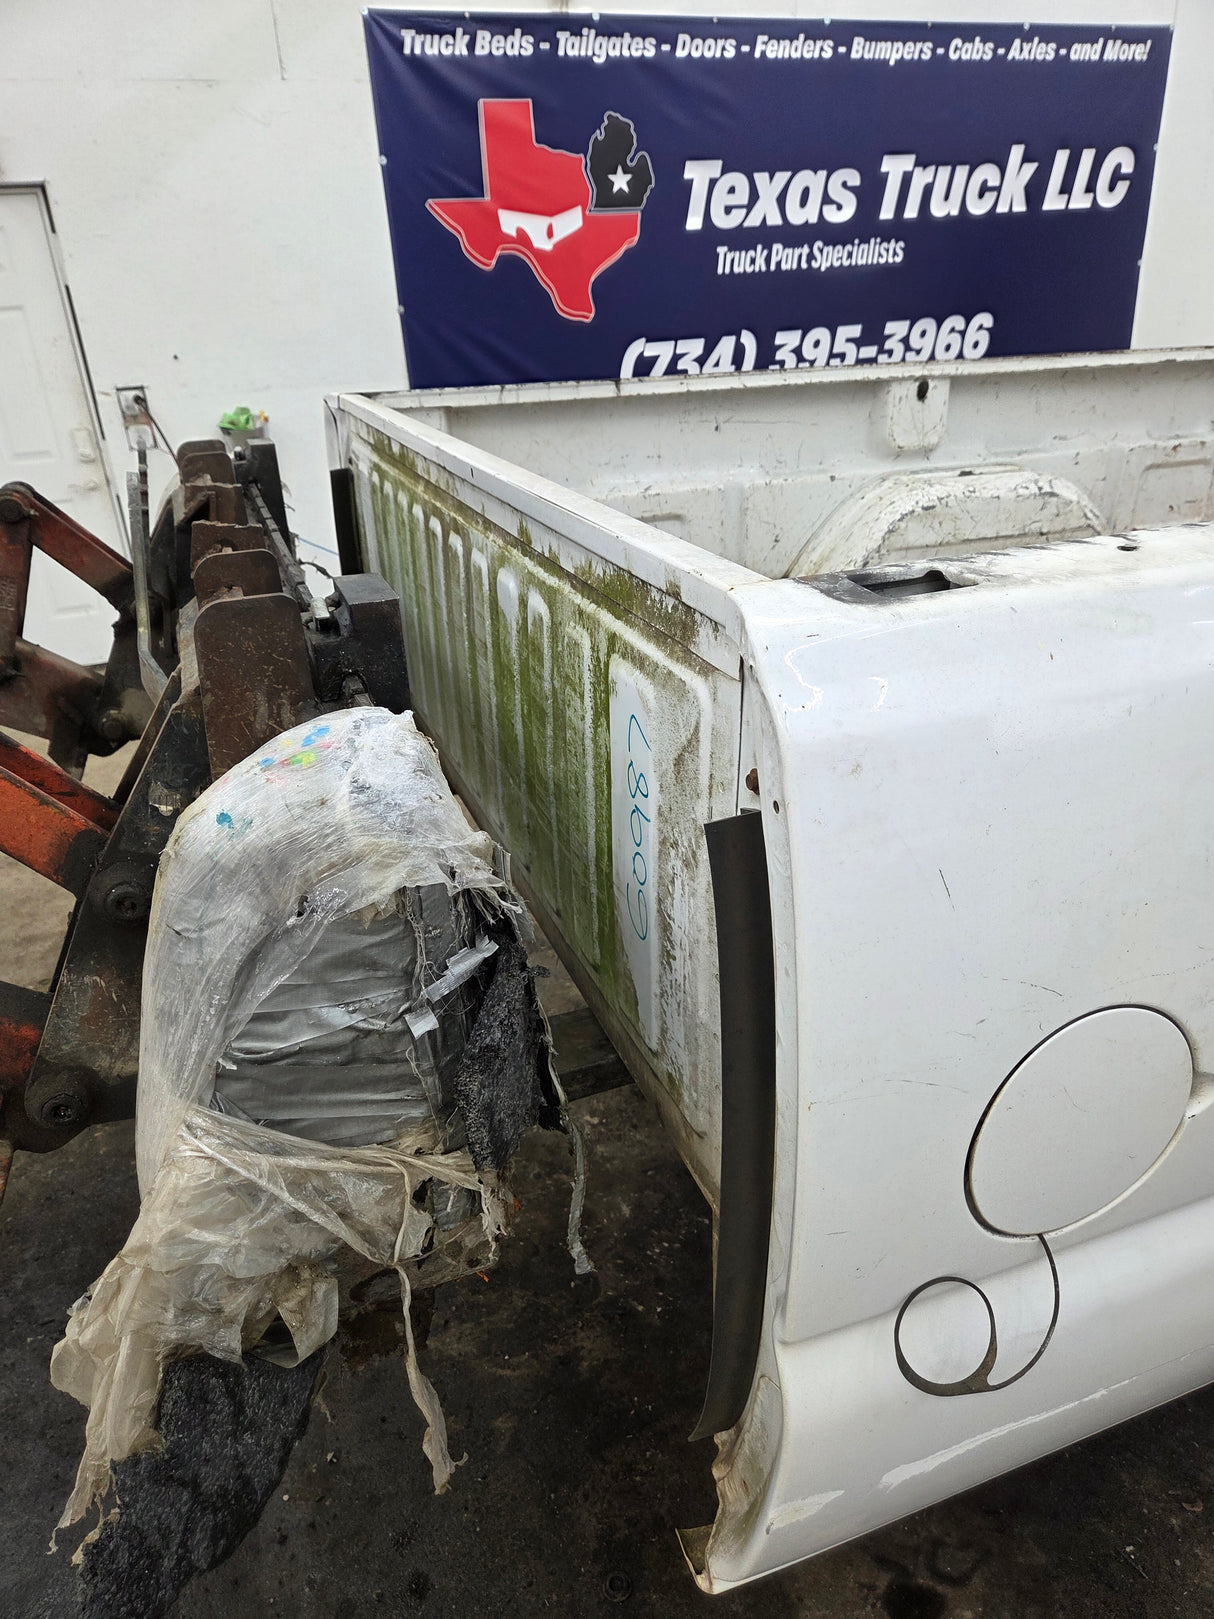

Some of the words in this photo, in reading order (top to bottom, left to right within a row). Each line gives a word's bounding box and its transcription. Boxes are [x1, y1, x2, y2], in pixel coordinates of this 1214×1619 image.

[401, 28, 470, 57] Truck
[475, 28, 534, 56] Beds
[557, 28, 656, 64] Tailgates
[675, 34, 736, 59] Doors
[754, 33, 834, 59] Fenders
[850, 37, 933, 66] Bumpers
[949, 36, 994, 60] Cabs
[1007, 37, 1057, 61] Axles
[1070, 37, 1102, 61] and
[1102, 38, 1152, 61] More!
[683, 160, 861, 231] Texas
[879, 144, 1038, 220] Truck
[1041, 147, 1135, 211] LLC
[717, 244, 768, 274] Truck
[770, 243, 810, 271] Part
[811, 237, 904, 272] Specialists
[619, 329, 758, 378] (734)
[768, 311, 994, 370] 395-3966
